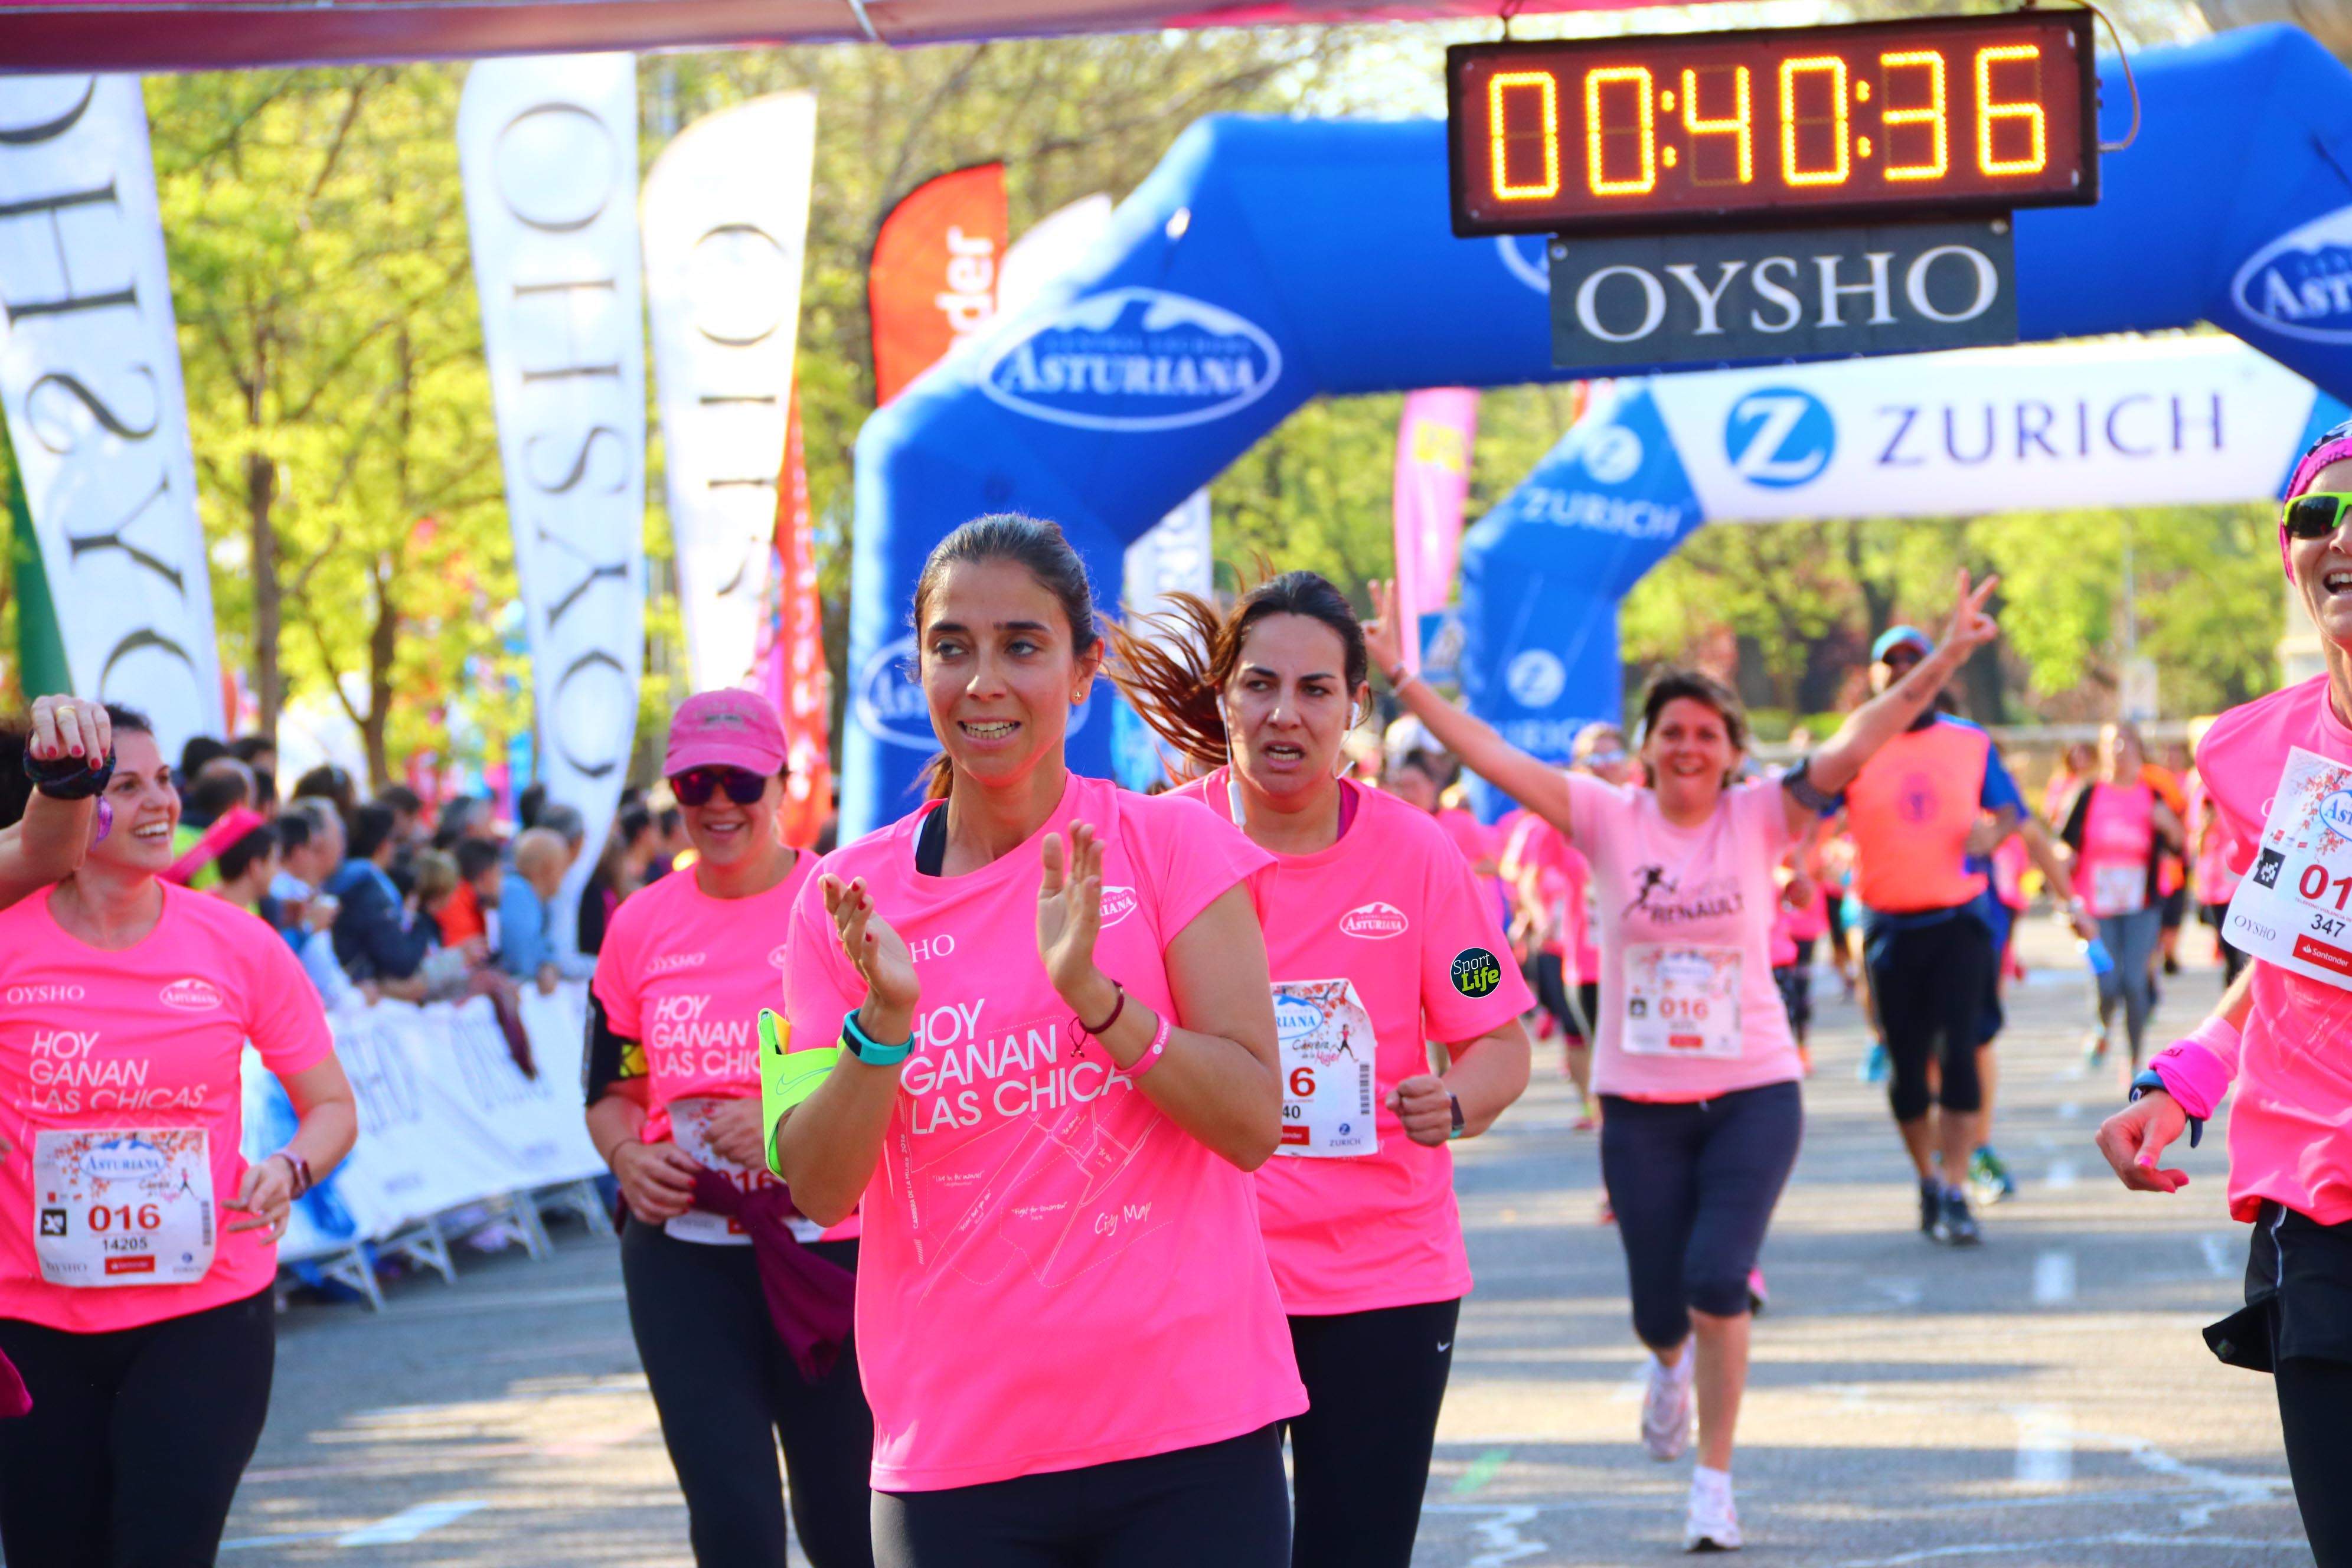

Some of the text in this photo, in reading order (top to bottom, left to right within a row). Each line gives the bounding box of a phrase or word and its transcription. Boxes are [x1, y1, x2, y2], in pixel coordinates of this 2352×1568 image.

[1489, 44, 2047, 200] 00:40:36
[1576, 244, 1999, 343] OYSHO
[998, 341, 1257, 395] ASTURIANA
[492, 100, 636, 778] OYSHO
[1876, 388, 2226, 468] ZURICH
[1521, 487, 1681, 541] ZURICH
[1651, 893, 1745, 922] RENAULT
[1346, 917, 1402, 932] ASTURIANA
[2235, 915, 2276, 941] OYSHO
[2311, 913, 2346, 938] 347
[910, 934, 956, 963] HO
[2312, 948, 2349, 968] Santander
[1453, 953, 1491, 975] Sport
[1462, 967, 1500, 992] Life
[7, 985, 86, 1004] OYSHO
[654, 994, 711, 1021] HOY
[1658, 997, 1709, 1020] 016
[31, 1031, 100, 1059] HOY
[651, 1020, 750, 1050] GANAN
[30, 1058, 149, 1087] GANAN
[655, 1050, 695, 1078] LAS
[901, 1024, 1057, 1096] GANAN
[32, 1083, 207, 1114] LAS CHICAS
[912, 1060, 1134, 1134] LAS CHICA
[1329, 1139, 1361, 1147] ZURICH
[89, 1156, 160, 1171] ASTURIANA
[88, 1204, 161, 1232] 016
[1095, 1201, 1151, 1237] City Map
[103, 1237, 148, 1252] 14205
